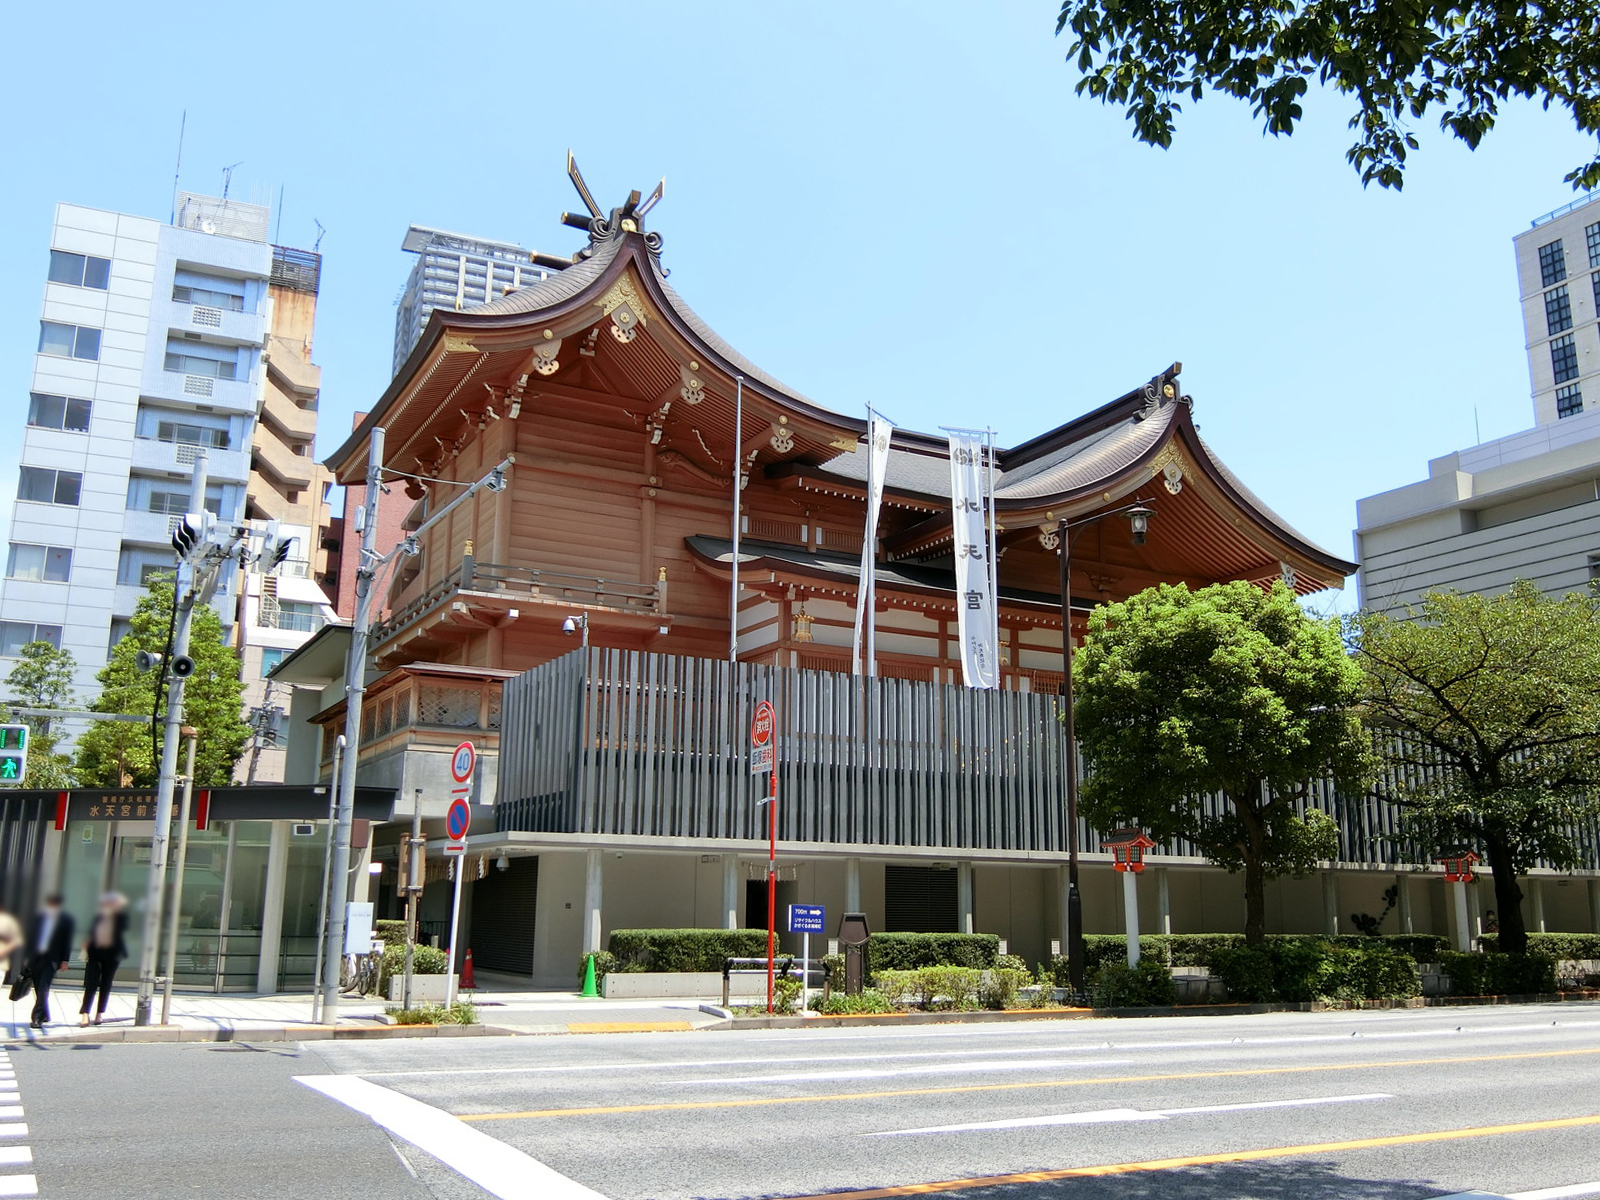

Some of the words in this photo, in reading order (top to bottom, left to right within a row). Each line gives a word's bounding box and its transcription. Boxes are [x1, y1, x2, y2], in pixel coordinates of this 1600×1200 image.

[956, 497, 983, 610] 水天宮
[456, 752, 470, 770] 40
